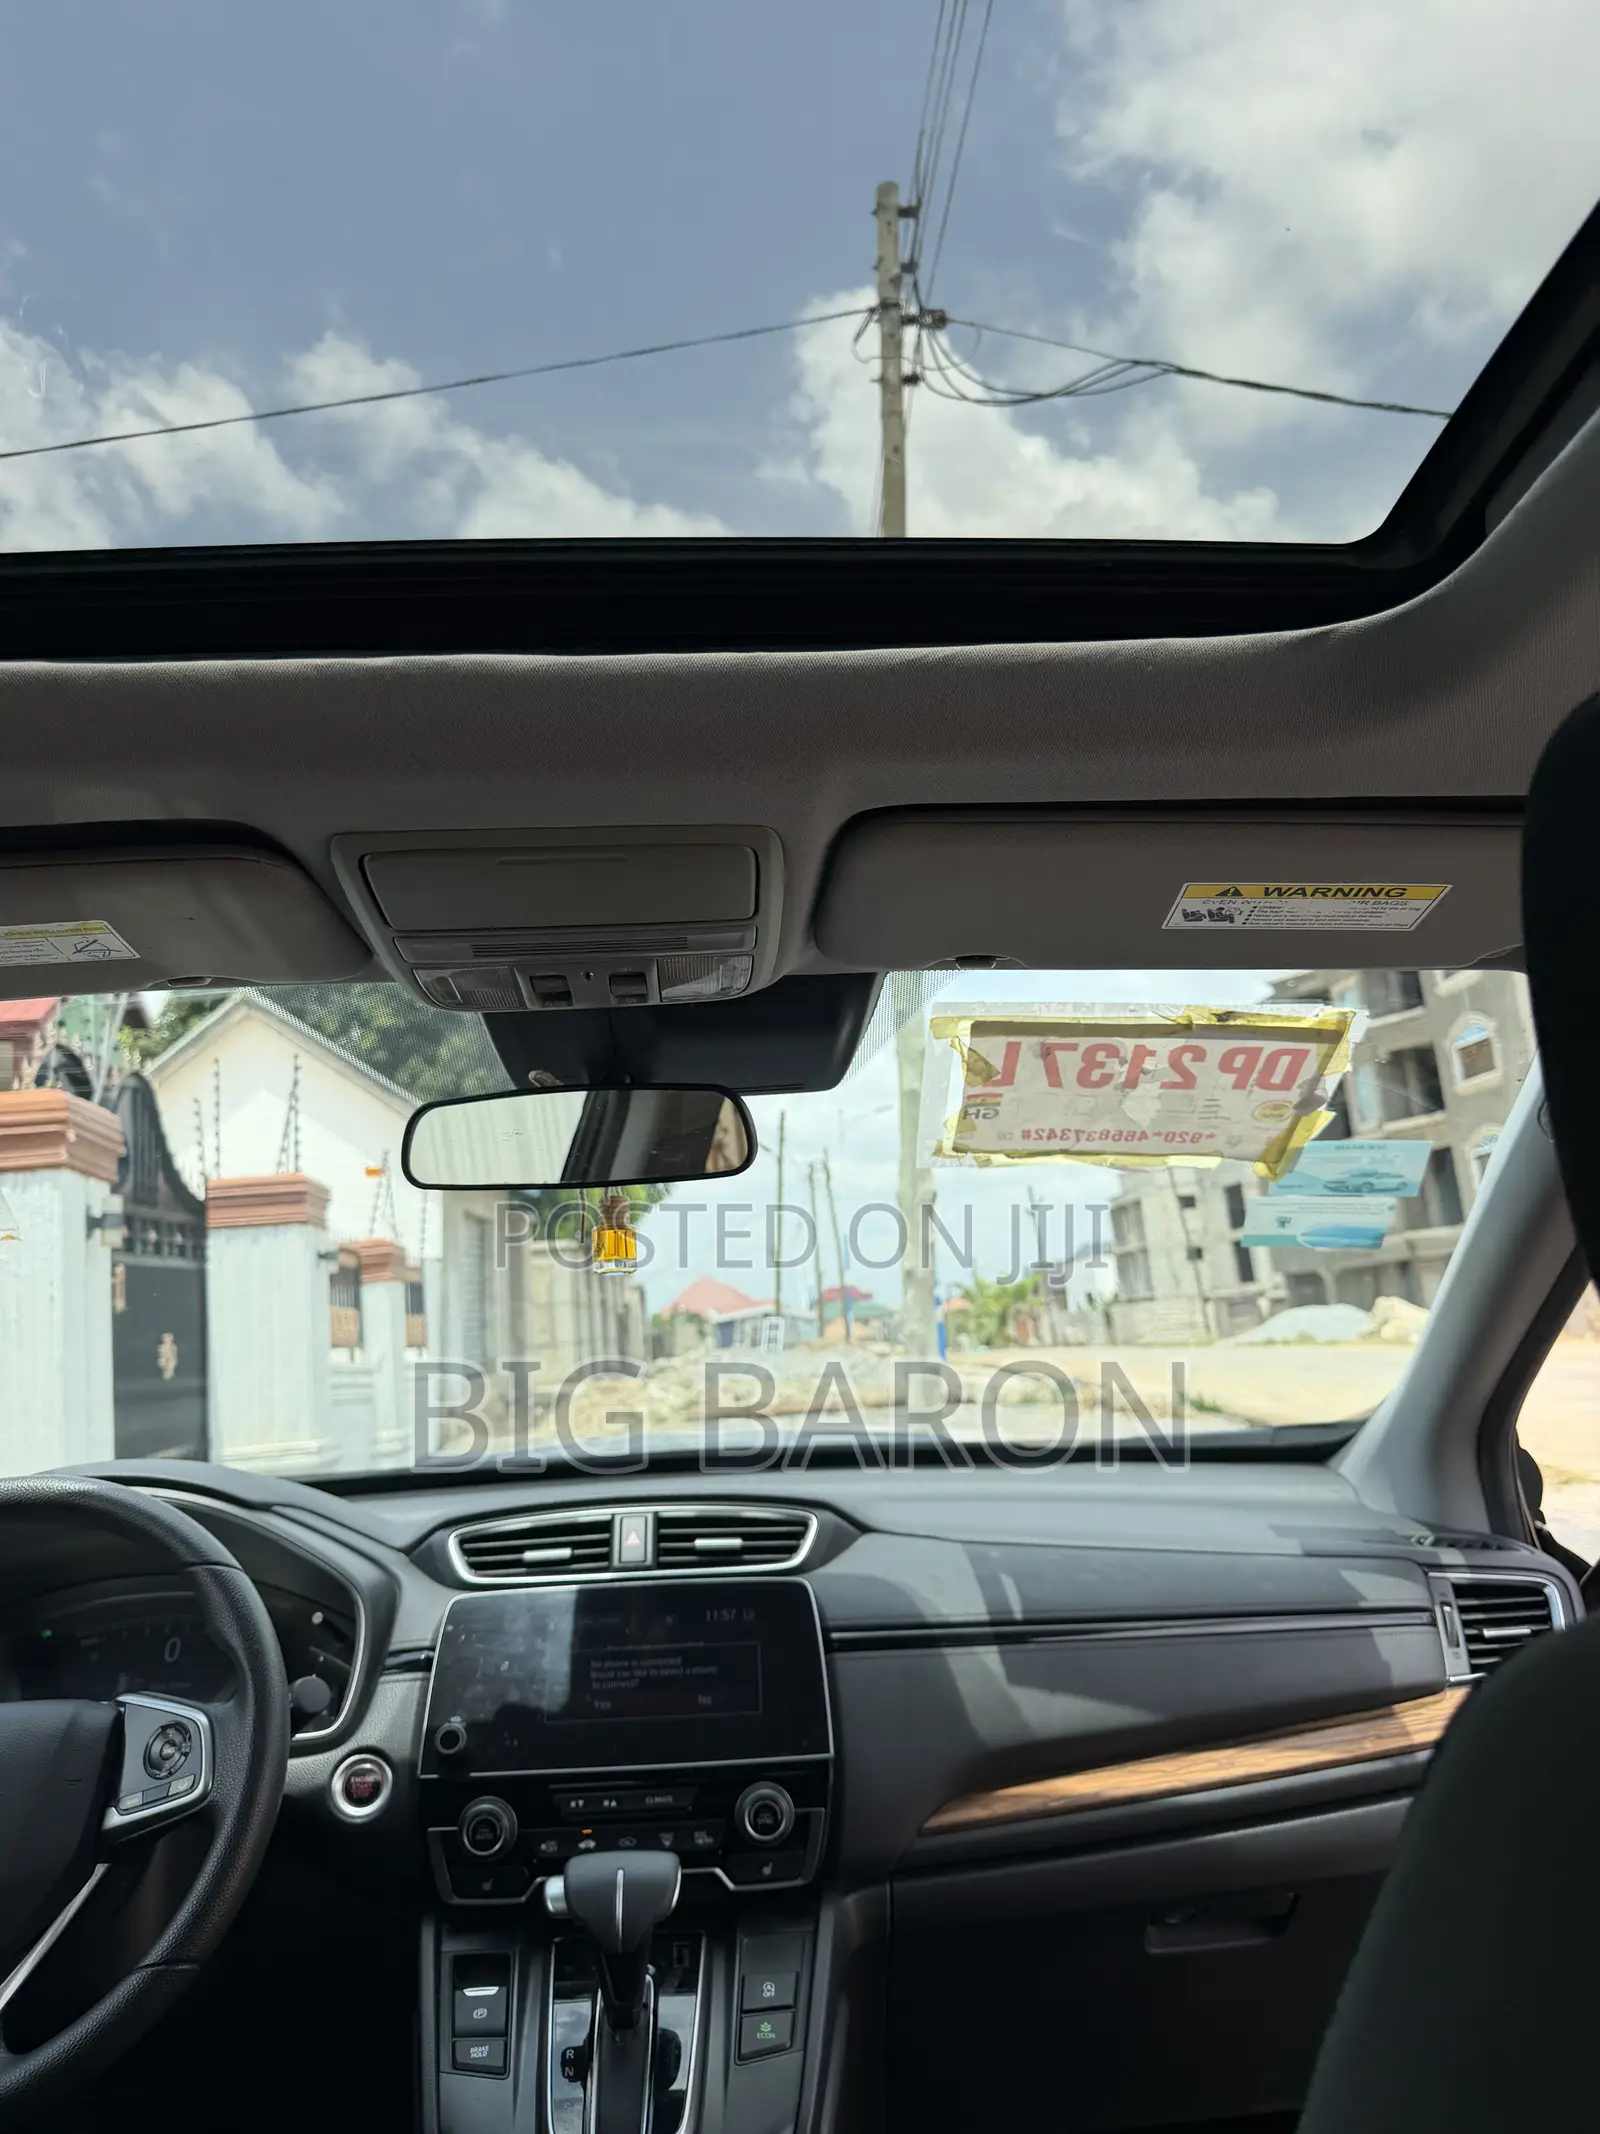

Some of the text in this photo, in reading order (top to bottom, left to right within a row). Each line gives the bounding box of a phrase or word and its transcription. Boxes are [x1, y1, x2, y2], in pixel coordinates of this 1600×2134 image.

[1263, 886, 1408, 898] WARNING
[705, 1608, 737, 1622] 11:57
[164, 1637, 182, 1662] 0
[645, 1795, 674, 1804] CLIMATE
[470, 2045, 490, 2053] BRAKE
[566, 2049, 575, 2059] R
[470, 2051, 488, 2059] HOLD
[564, 2066, 574, 2077] N
